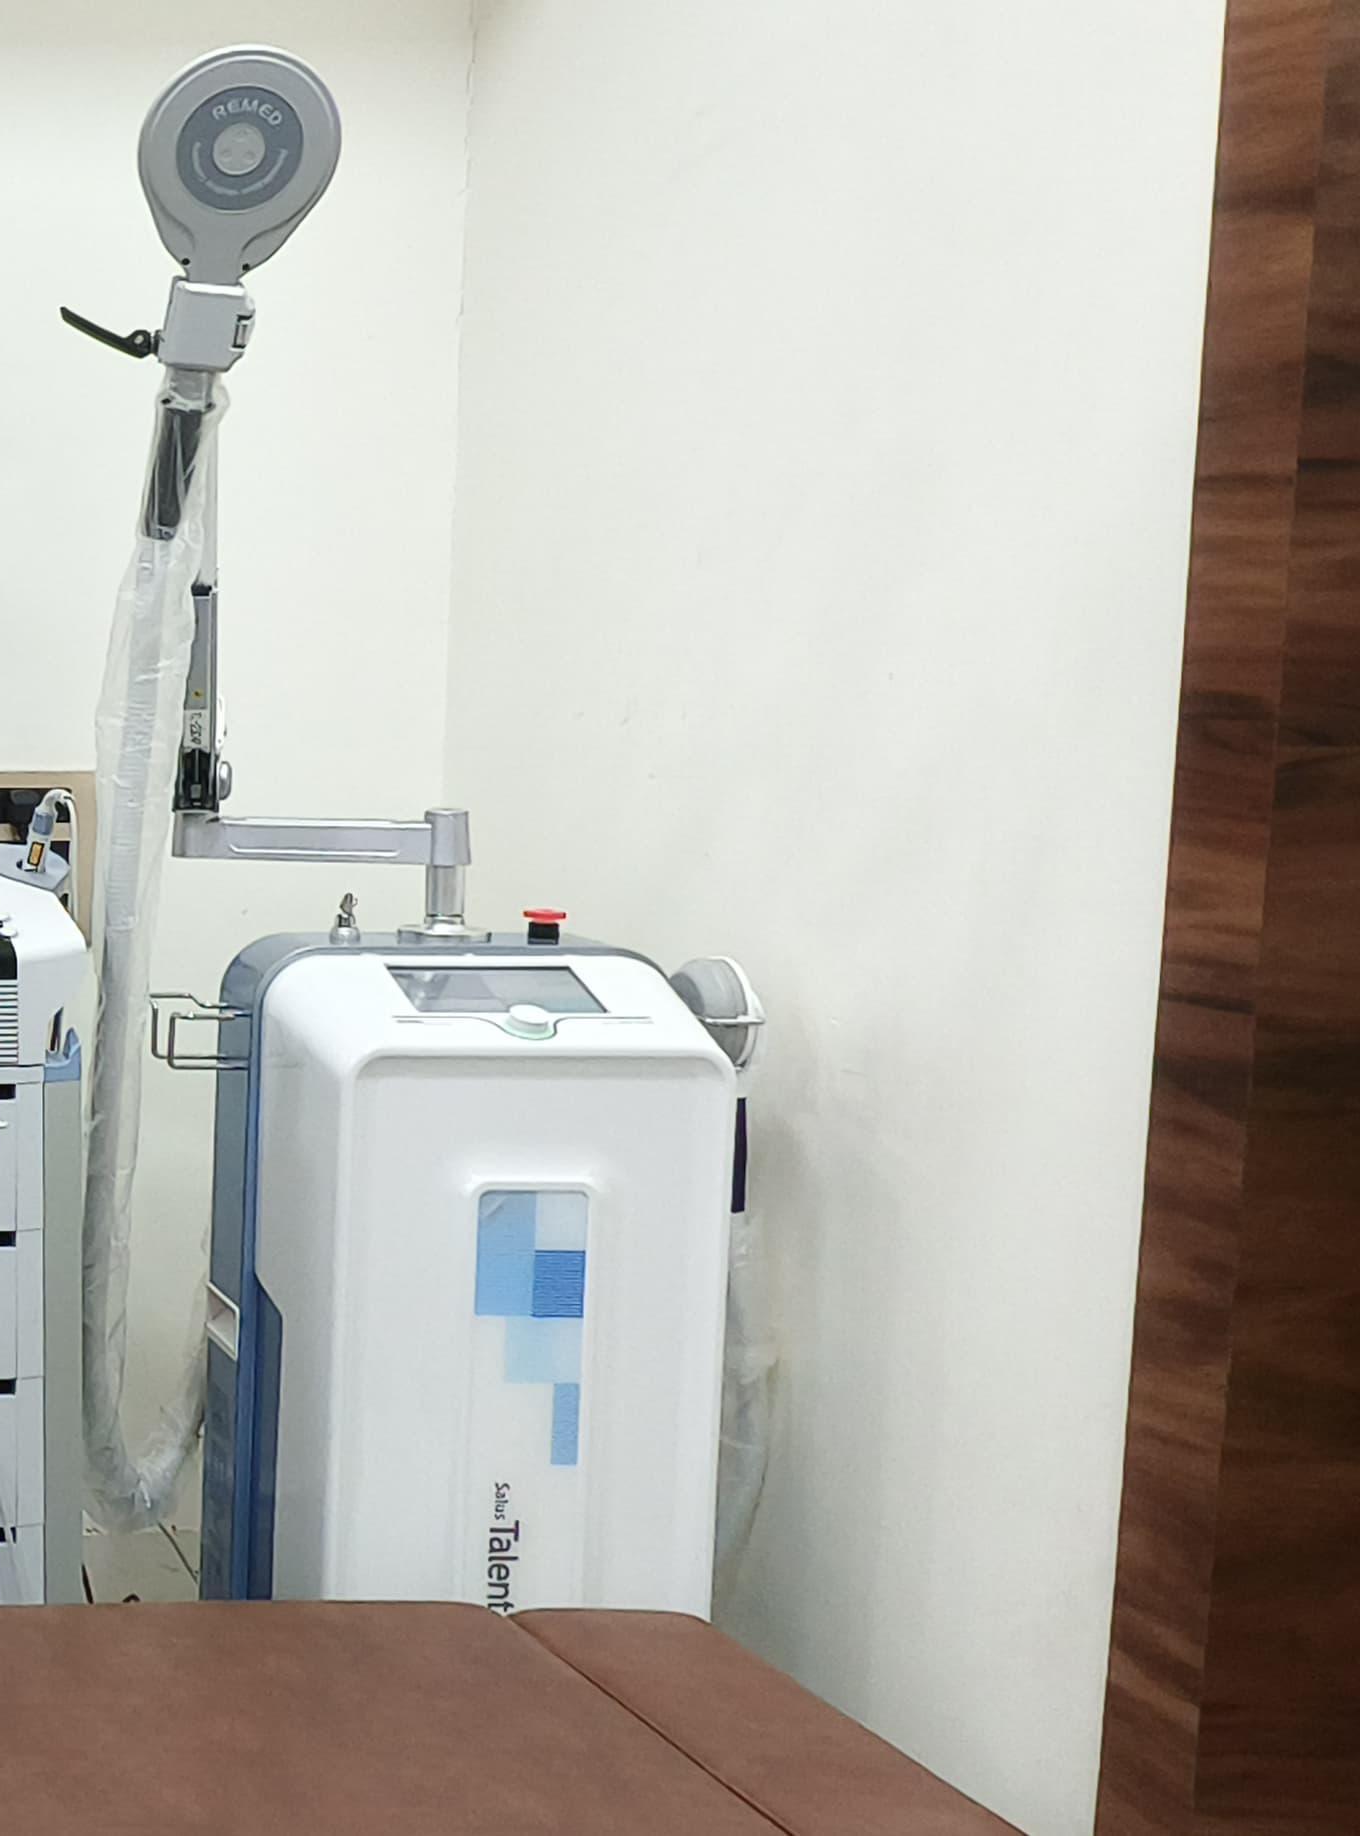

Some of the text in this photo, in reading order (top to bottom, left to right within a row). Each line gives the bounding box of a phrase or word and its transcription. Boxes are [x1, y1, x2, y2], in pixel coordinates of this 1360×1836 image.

[212, 98, 282, 126] REMED
[494, 1482, 511, 1520] Salus
[487, 1519, 520, 1612] Talent
